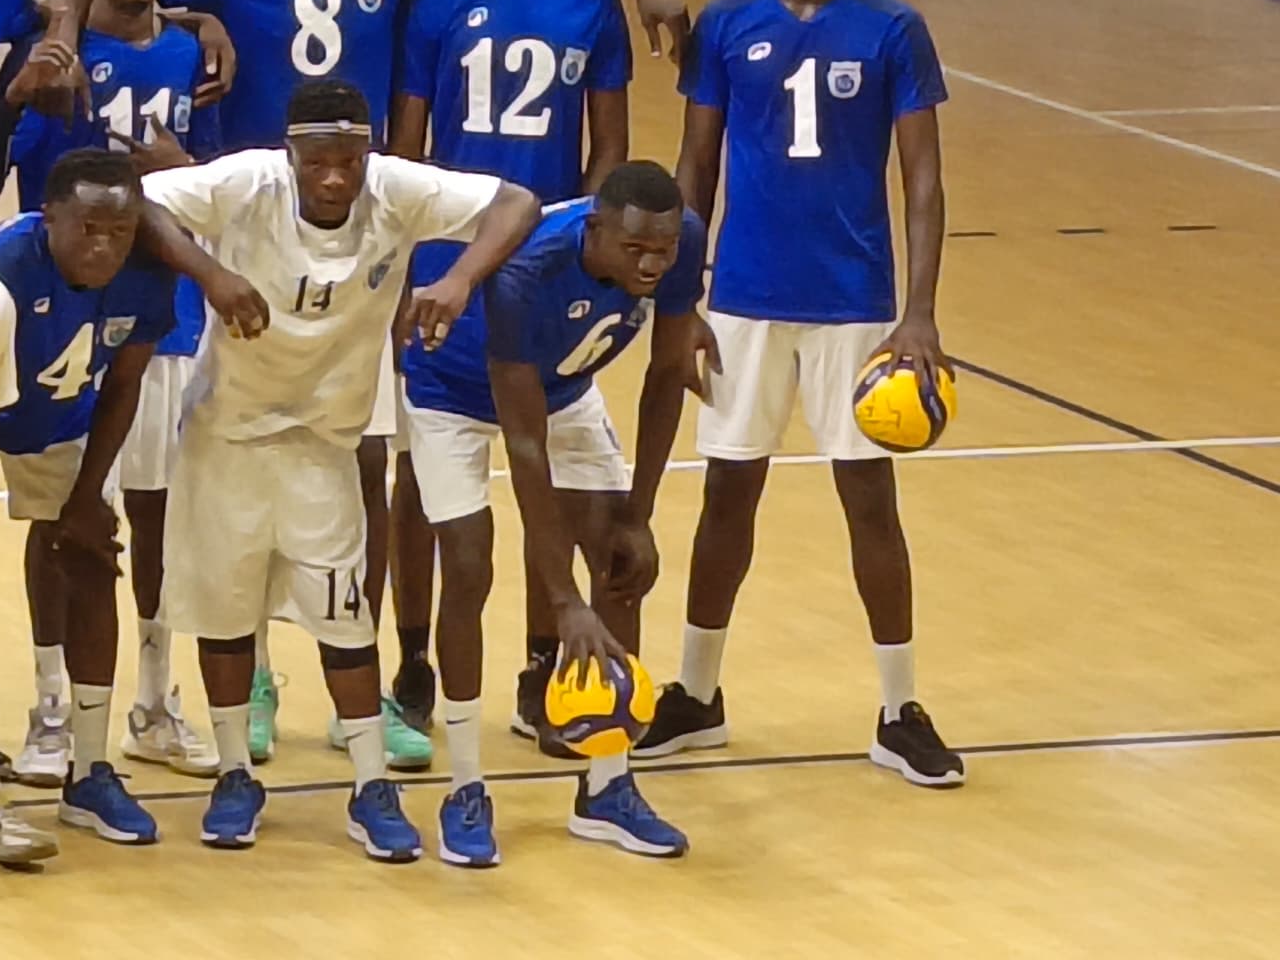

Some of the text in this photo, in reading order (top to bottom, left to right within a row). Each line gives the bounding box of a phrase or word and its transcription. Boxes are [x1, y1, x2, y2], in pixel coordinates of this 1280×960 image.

[99, 87, 170, 153] 11
[461, 37, 557, 136] 12
[784, 58, 821, 158] 1
[37, 323, 94, 399] 4
[326, 568, 361, 621] 14
